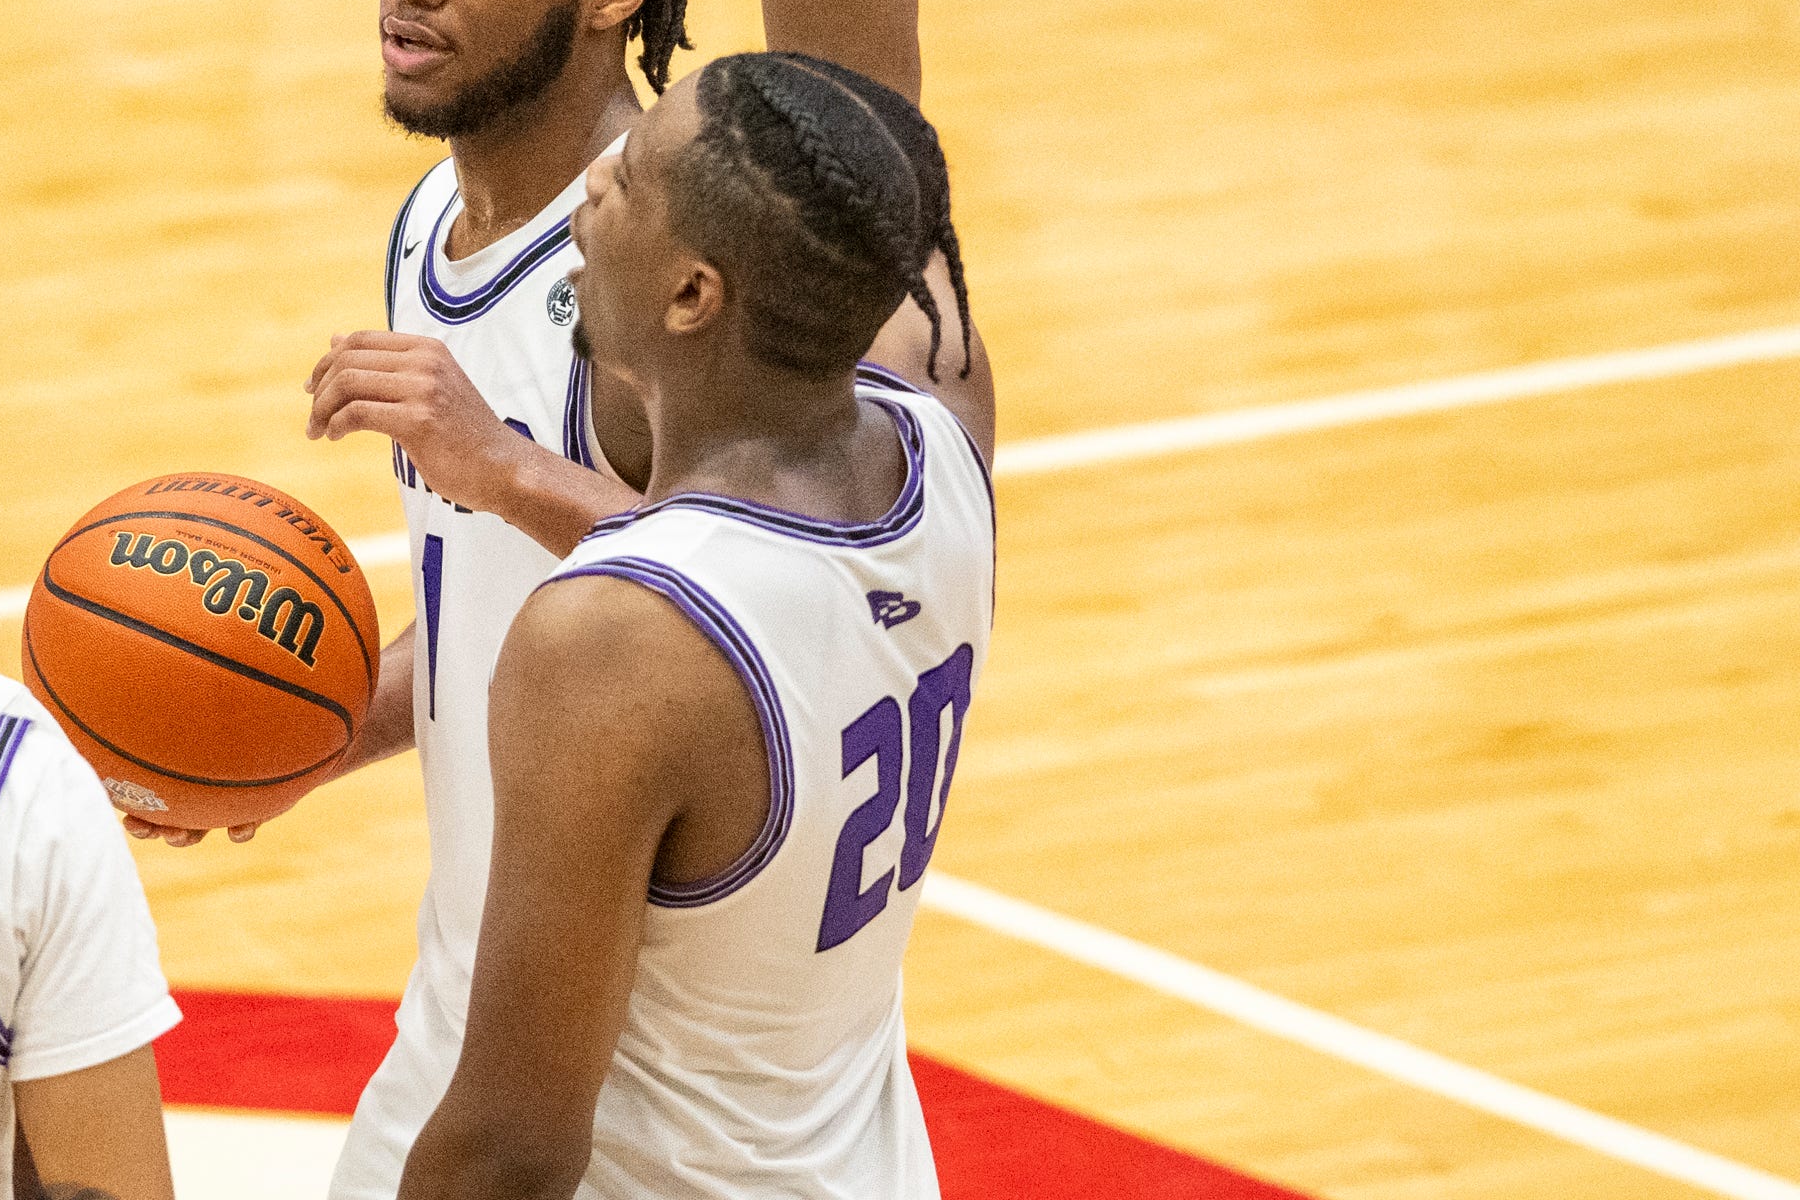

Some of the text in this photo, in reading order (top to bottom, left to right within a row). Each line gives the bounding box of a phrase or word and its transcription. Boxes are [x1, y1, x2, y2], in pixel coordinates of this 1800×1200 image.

[146, 478, 352, 574] EVOLUTION
[175, 529, 202, 543] BALL
[109, 531, 326, 671] Wilson
[422, 533, 443, 721] 1
[815, 642, 973, 954] 20
